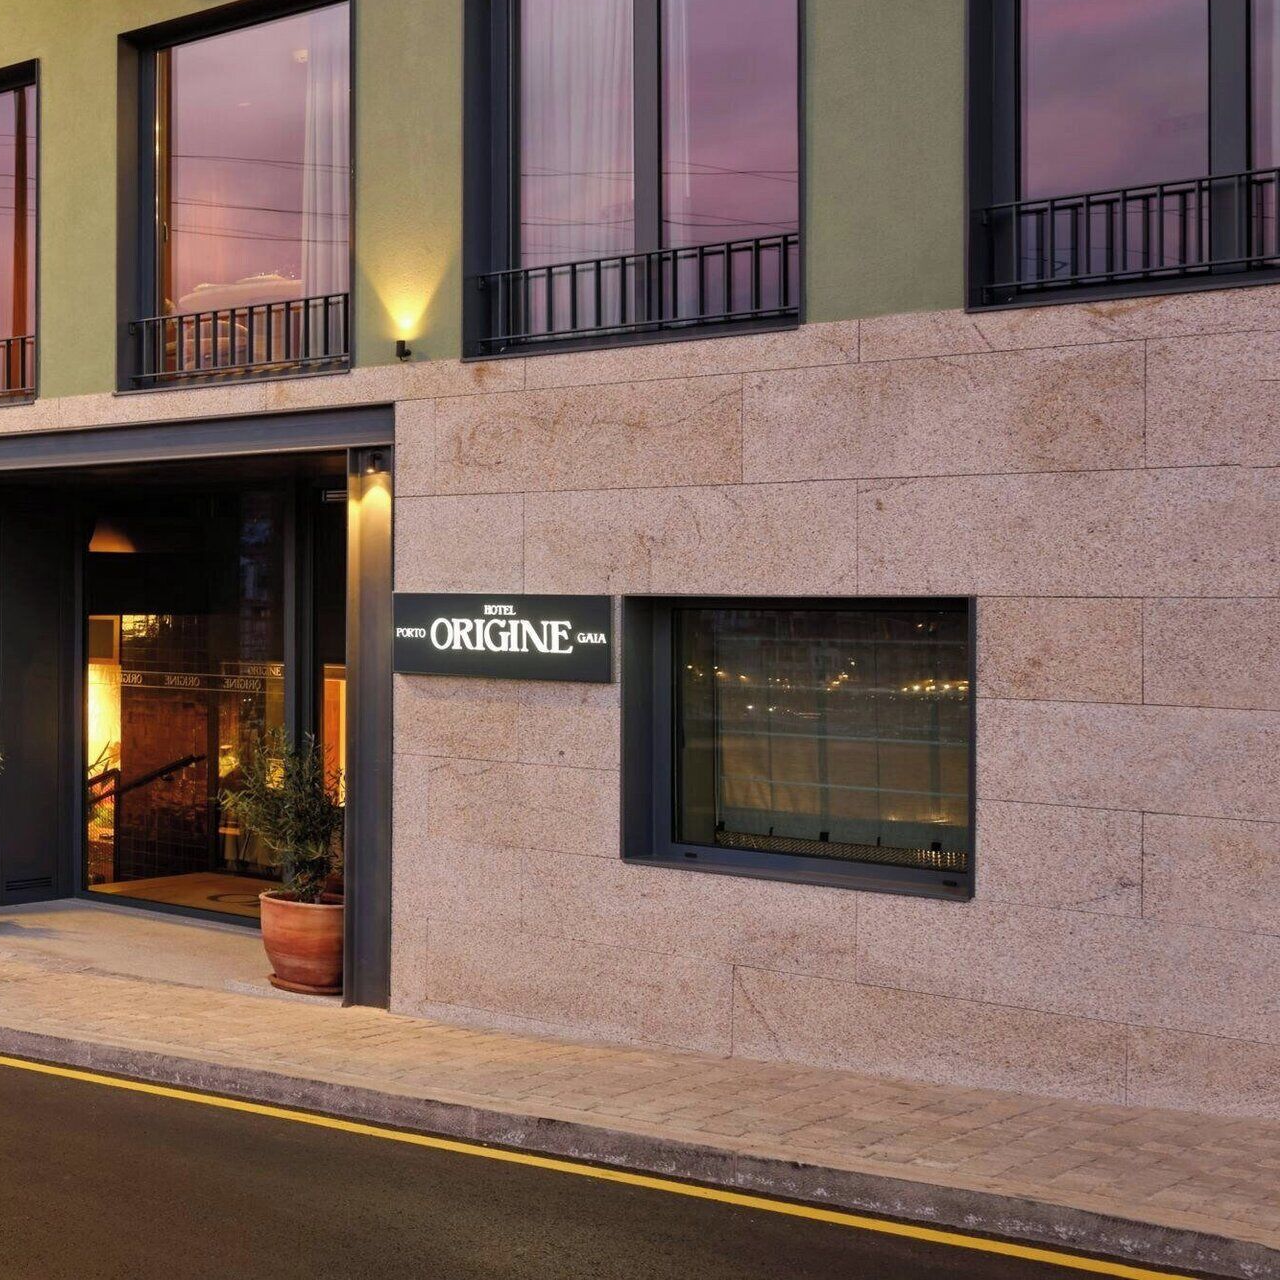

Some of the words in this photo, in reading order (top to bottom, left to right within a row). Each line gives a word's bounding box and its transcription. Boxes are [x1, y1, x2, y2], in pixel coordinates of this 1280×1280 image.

[484, 605, 516, 616] HOTEL
[396, 627, 426, 639] PORTO
[430, 617, 573, 654] ORIGINE
[577, 632, 607, 644] GAIA
